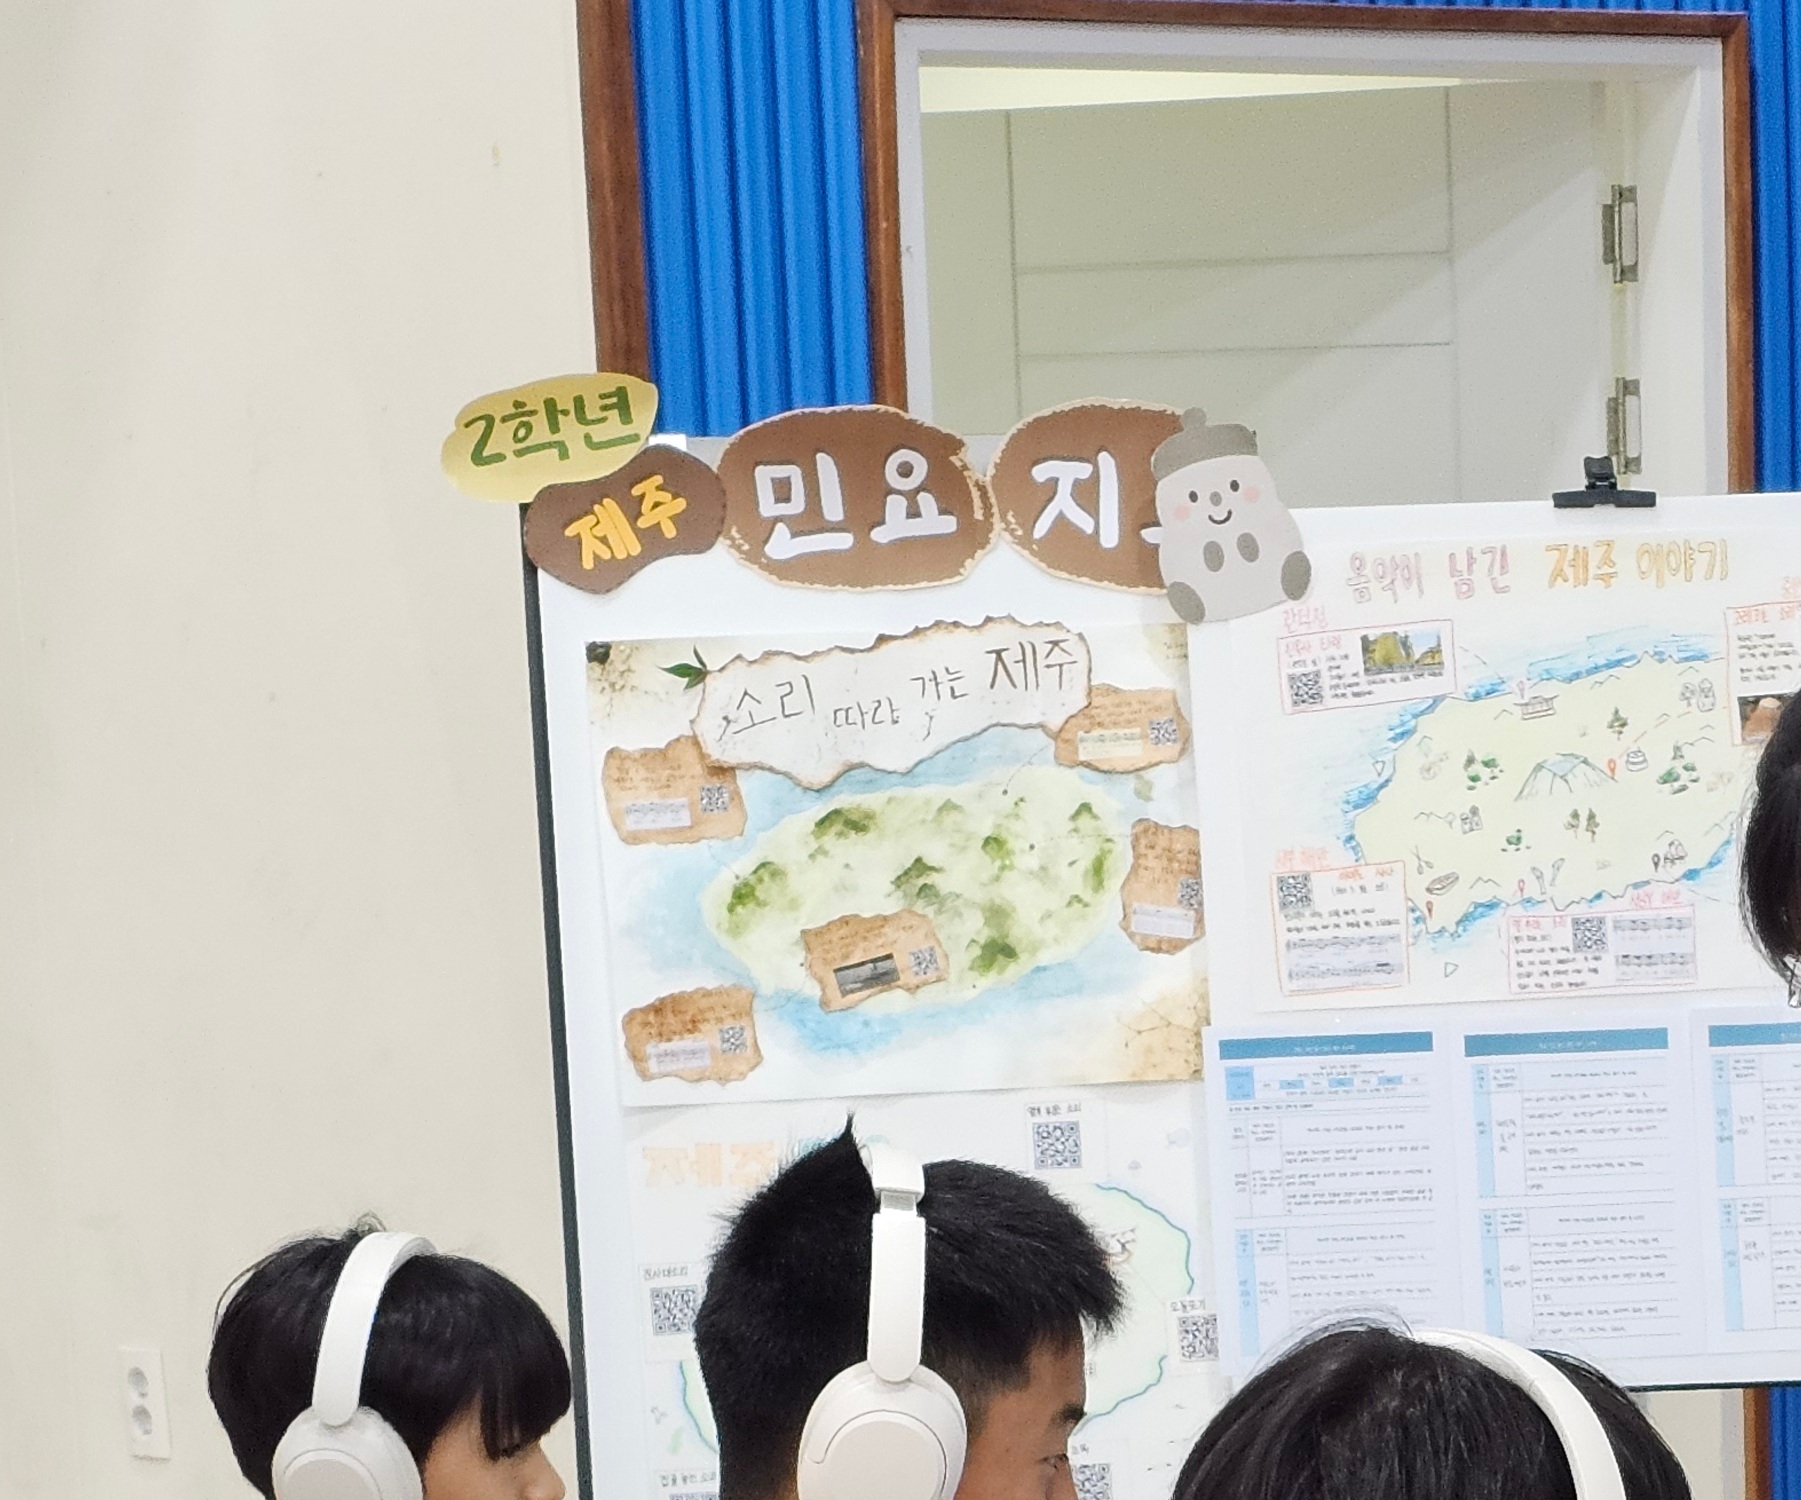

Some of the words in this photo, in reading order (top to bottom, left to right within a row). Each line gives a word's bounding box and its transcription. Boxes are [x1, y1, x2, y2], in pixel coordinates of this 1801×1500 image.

[463, 385, 641, 468] 2학년
[564, 474, 688, 570] 제주
[754, 448, 958, 559] 민요
[1030, 449, 1164, 548] 지
[1346, 550, 1424, 603] 음악이
[1448, 544, 1511, 599] 남긴
[1545, 540, 1619, 588] 제주
[1637, 538, 1729, 587] 이야기
[733, 675, 816, 734] 소리
[984, 639, 1078, 692] 제주
